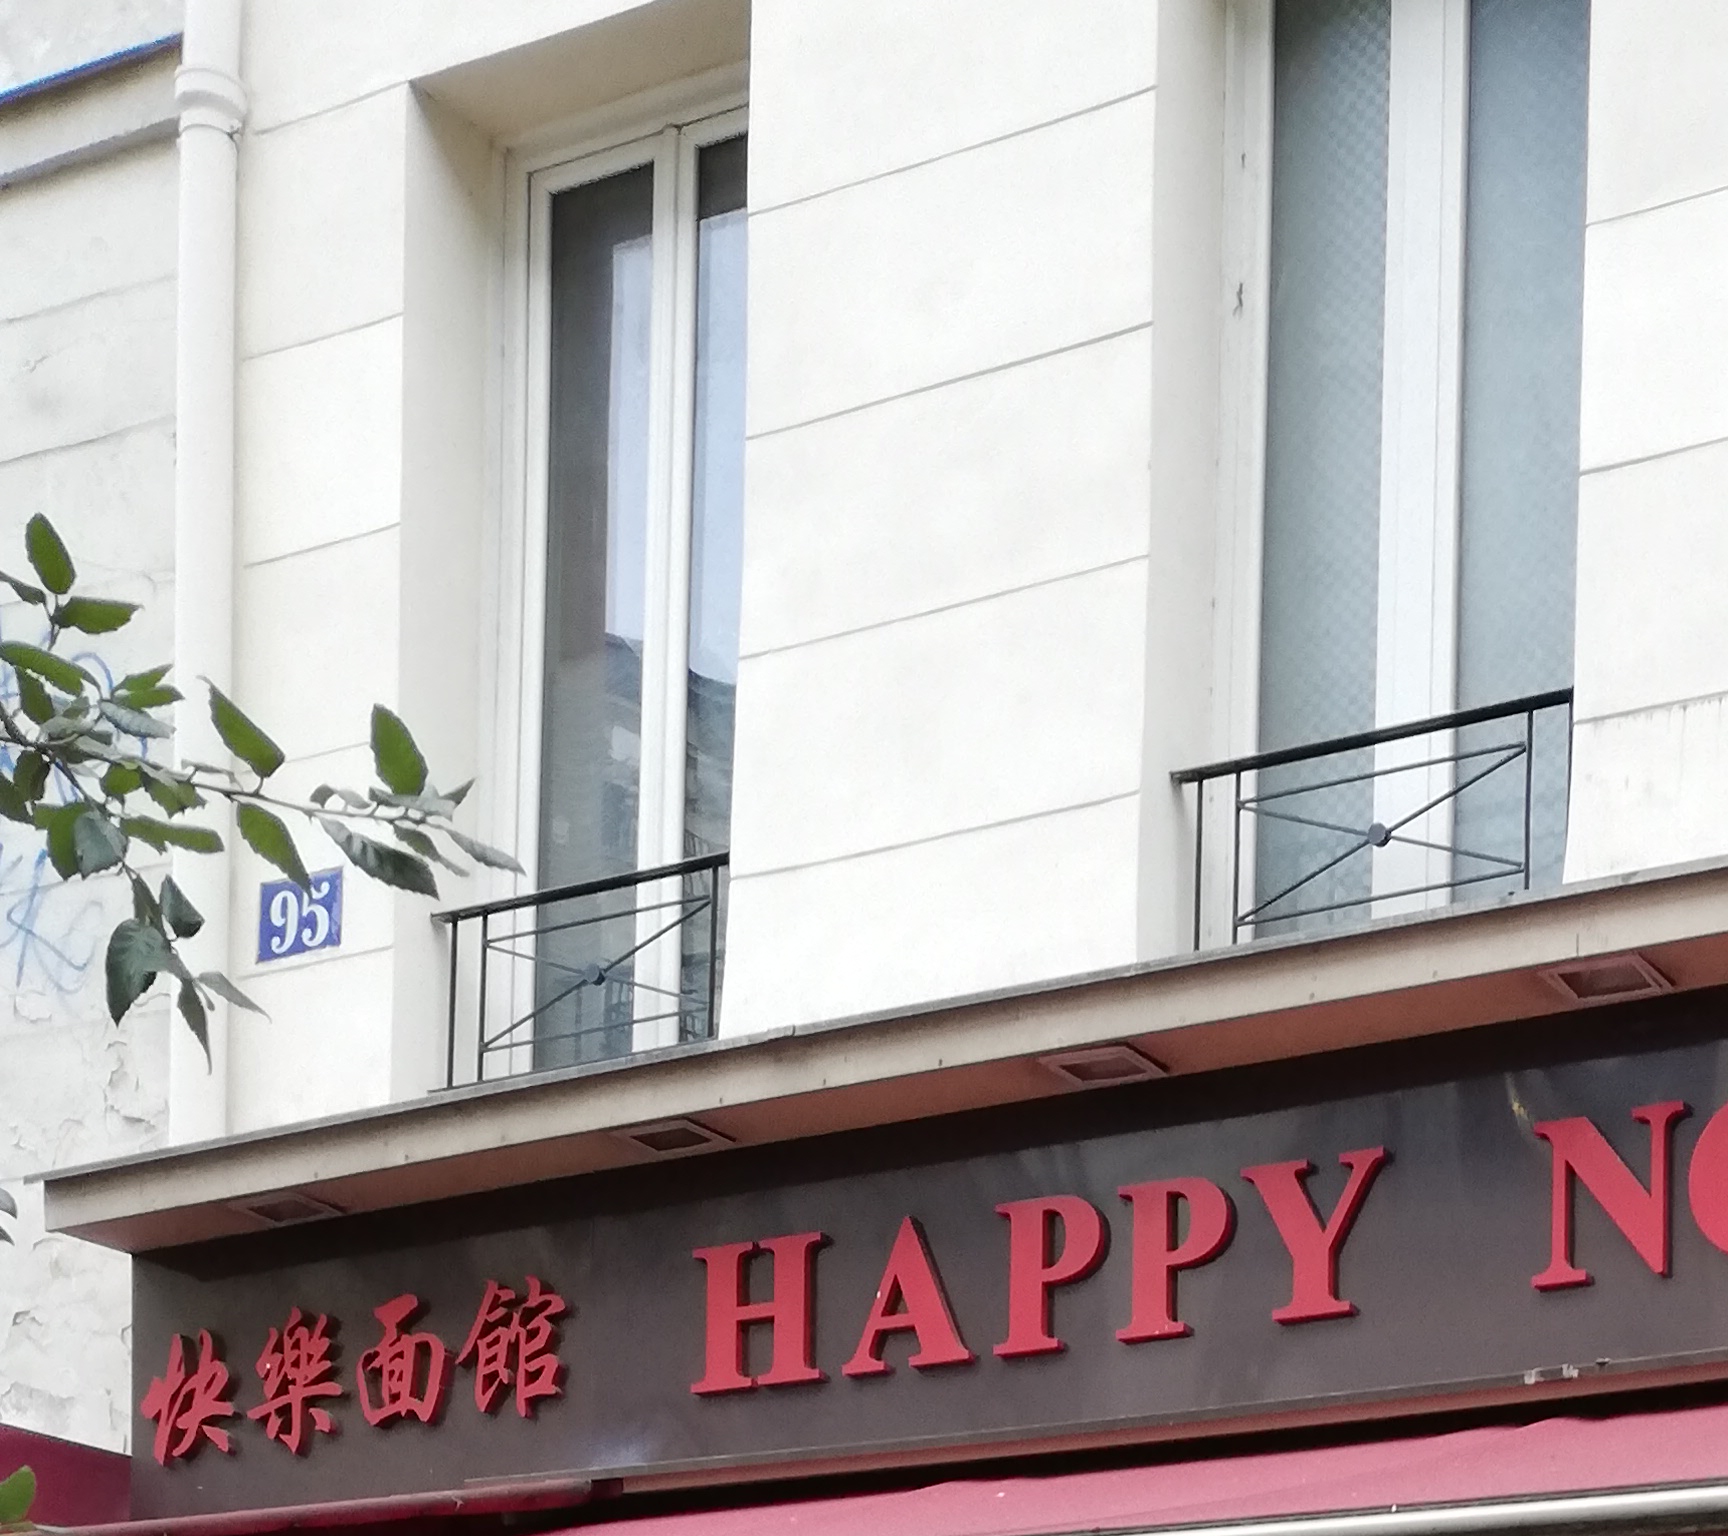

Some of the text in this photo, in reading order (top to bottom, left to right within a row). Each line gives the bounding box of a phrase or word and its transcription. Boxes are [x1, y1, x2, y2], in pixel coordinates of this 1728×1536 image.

[269, 880, 332, 956] 95
[691, 1146, 1384, 1395] HAPPY
[141, 1277, 566, 1466] 快樂面館
